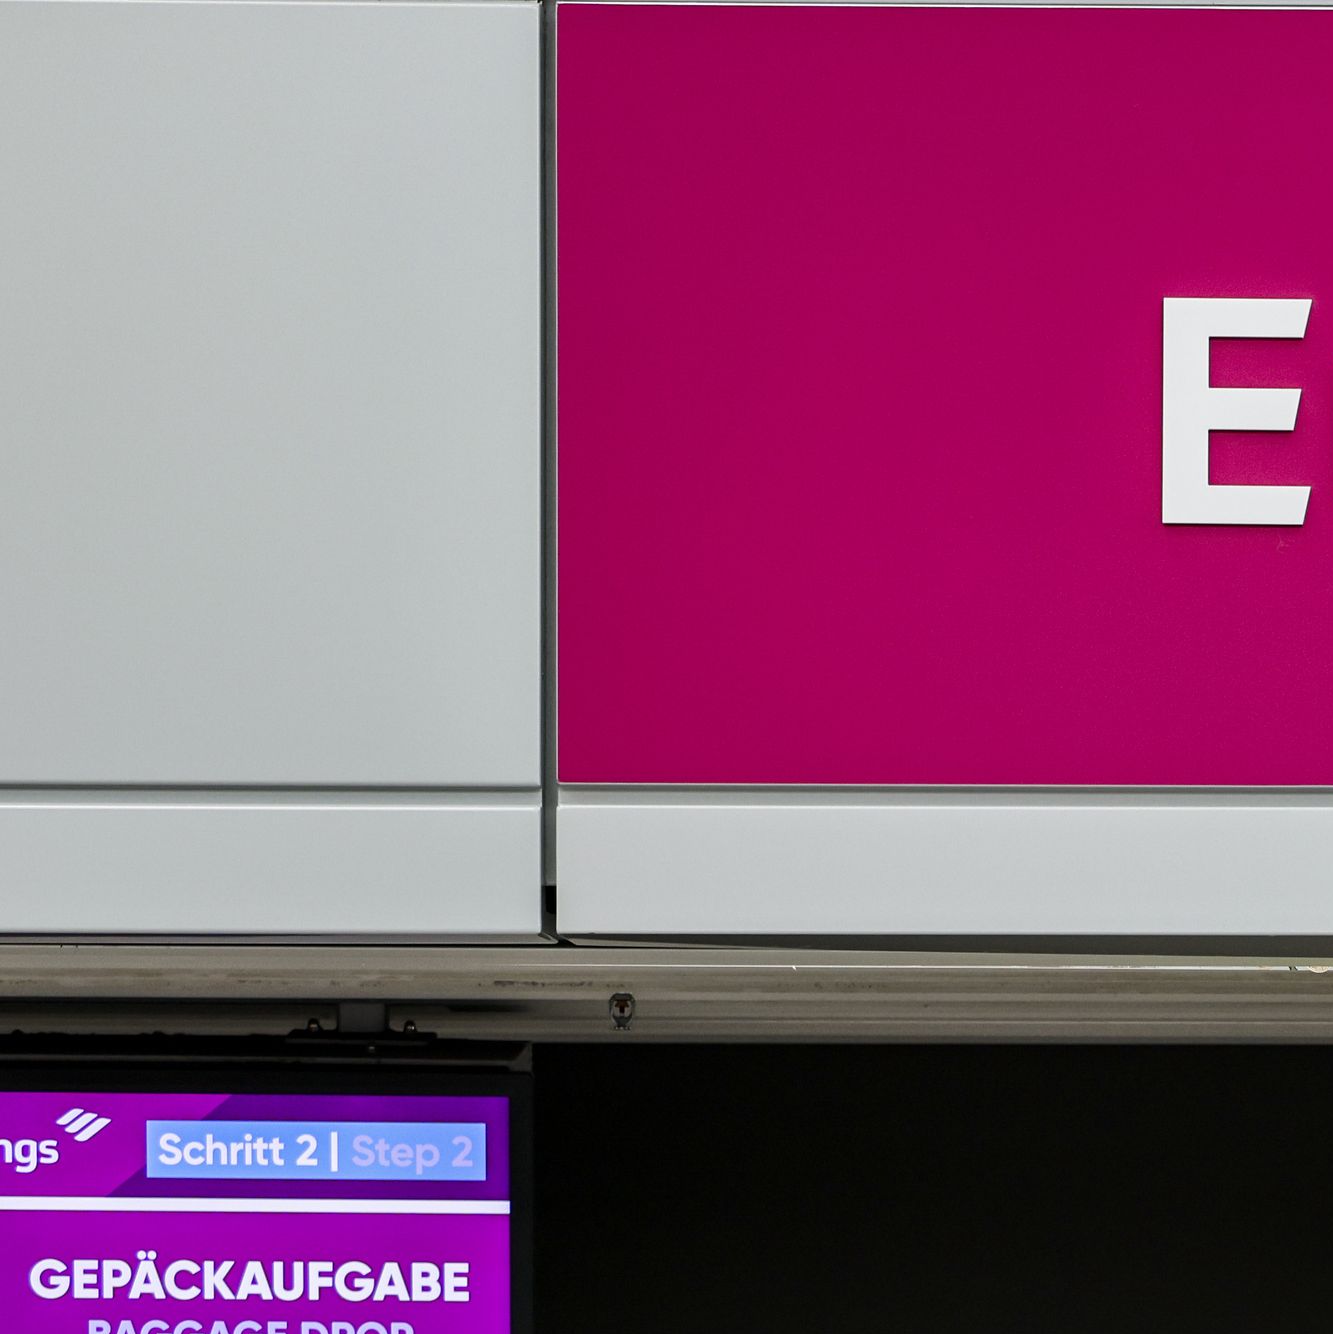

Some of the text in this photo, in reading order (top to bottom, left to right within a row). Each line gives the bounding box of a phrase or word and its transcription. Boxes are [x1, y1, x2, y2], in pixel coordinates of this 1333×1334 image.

[158, 1133, 285, 1166] Schritt
[296, 1133, 318, 1167] 2
[352, 1135, 441, 1175] Step
[452, 1135, 474, 1168] 2
[28, 1250, 471, 1302] GEPÄCKAUFGABE
